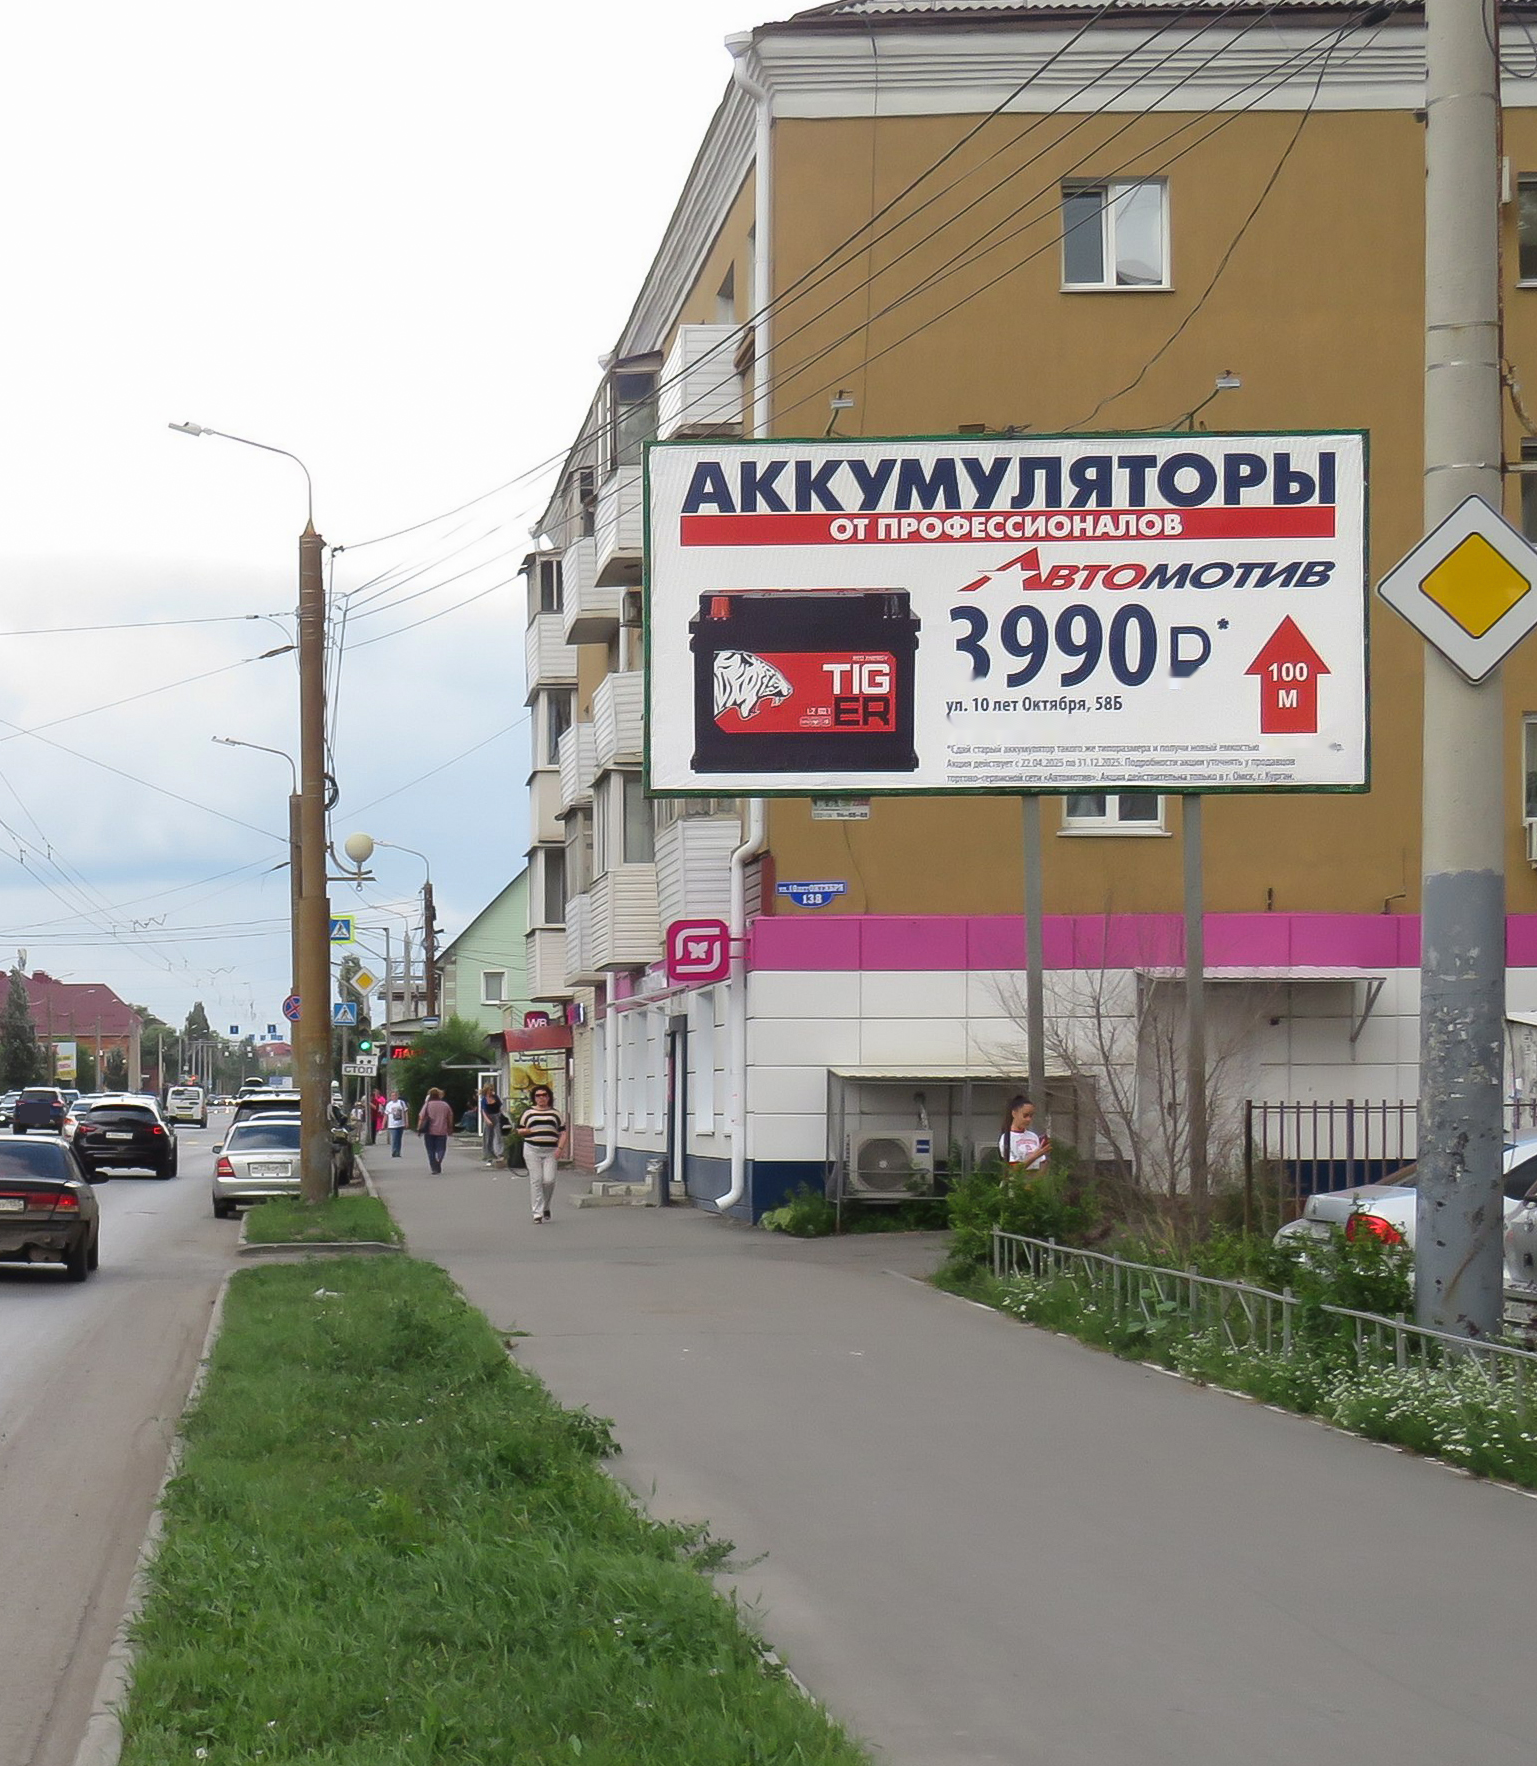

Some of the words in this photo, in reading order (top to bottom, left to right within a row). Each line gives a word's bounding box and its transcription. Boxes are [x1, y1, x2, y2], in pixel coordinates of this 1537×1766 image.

[680, 451, 1337, 513] АККУМУЛЯТОРЫ
[830, 518, 869, 540] ОТ
[876, 513, 1184, 540] ПРОФЕССИОНАЛОВ
[949, 603, 1158, 688] 3990
[822, 663, 891, 695] TIG
[1268, 662, 1309, 682] 100
[834, 696, 891, 727] ER
[945, 700, 968, 714] ул.
[972, 698, 989, 712] 10
[992, 700, 1018, 713] лет
[1022, 696, 1092, 714] Октября,
[1095, 697, 1124, 711] 58Б
[802, 894, 823, 905] 138
[343, 1064, 375, 1076] СТОП
